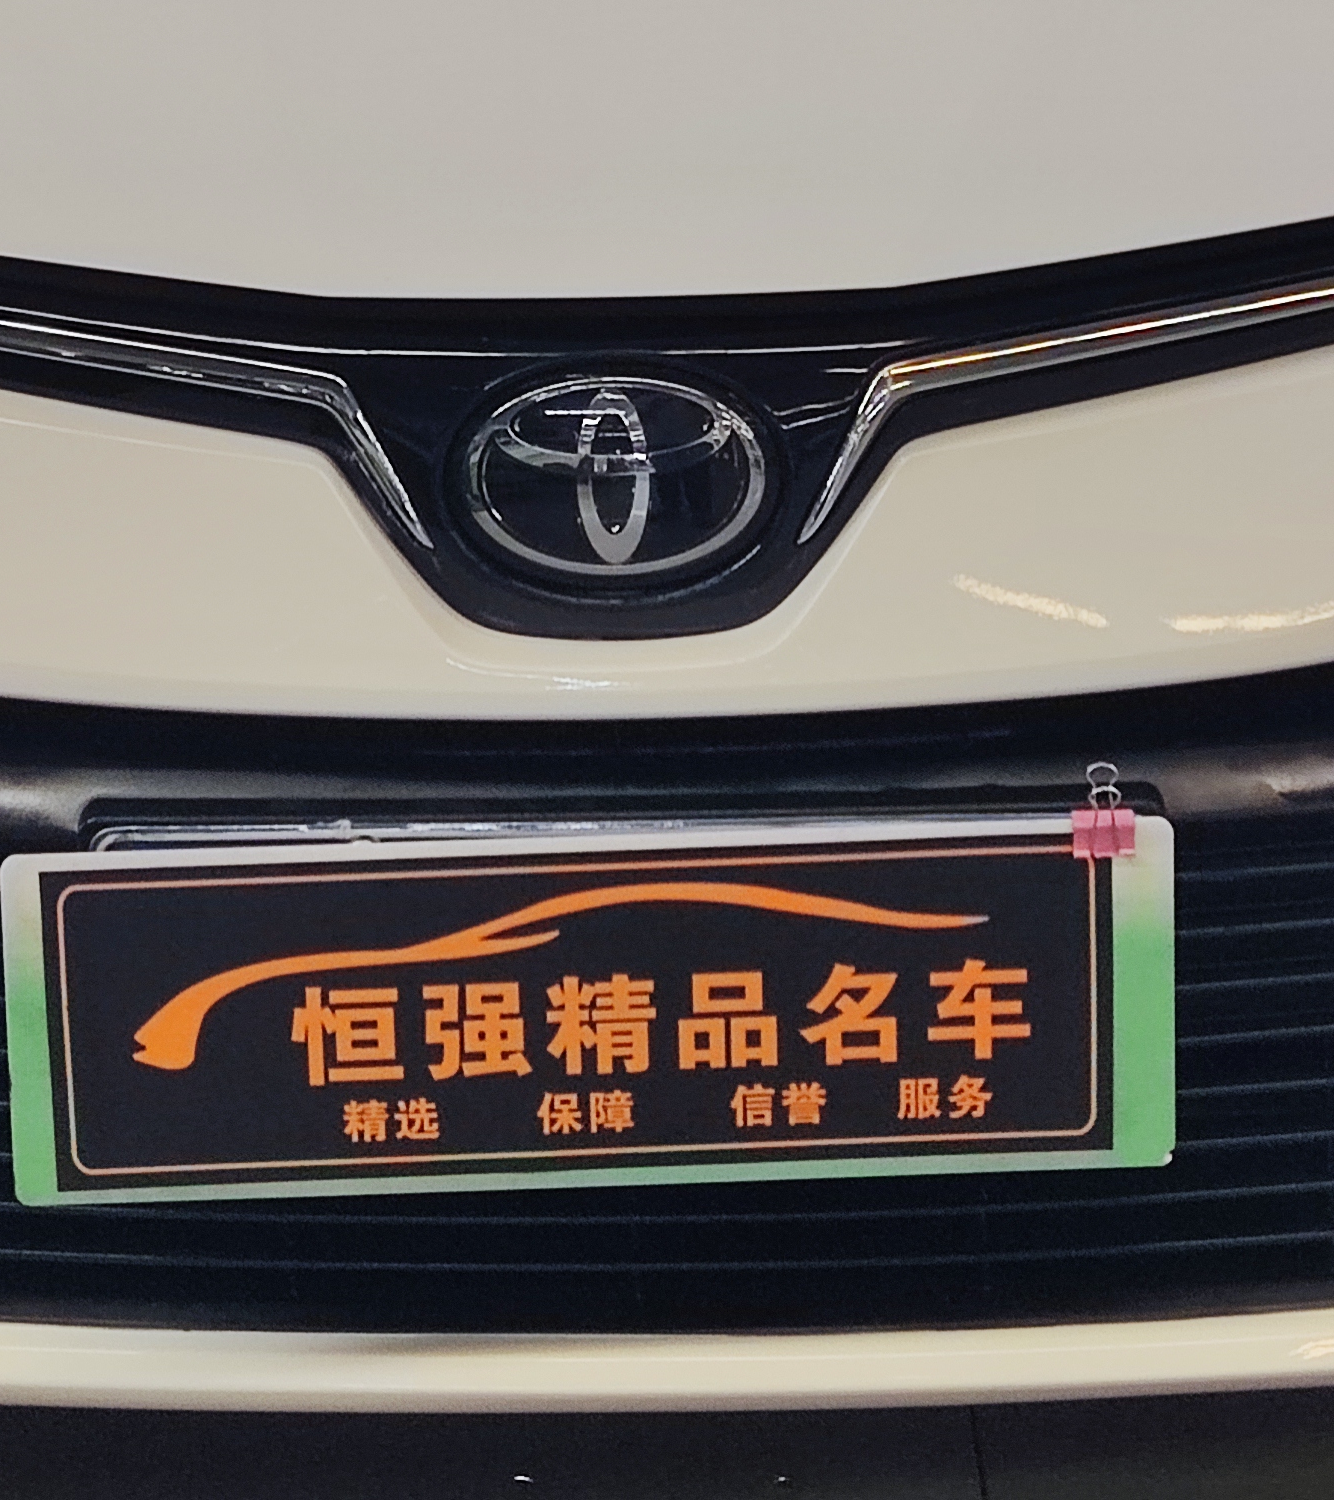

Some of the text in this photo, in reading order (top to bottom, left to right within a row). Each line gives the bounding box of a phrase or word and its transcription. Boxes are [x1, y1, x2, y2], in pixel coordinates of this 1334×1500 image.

[290, 958, 1032, 1088] 恒强精品名车
[342, 1074, 994, 1142] 精选 保障 信誉 服务
